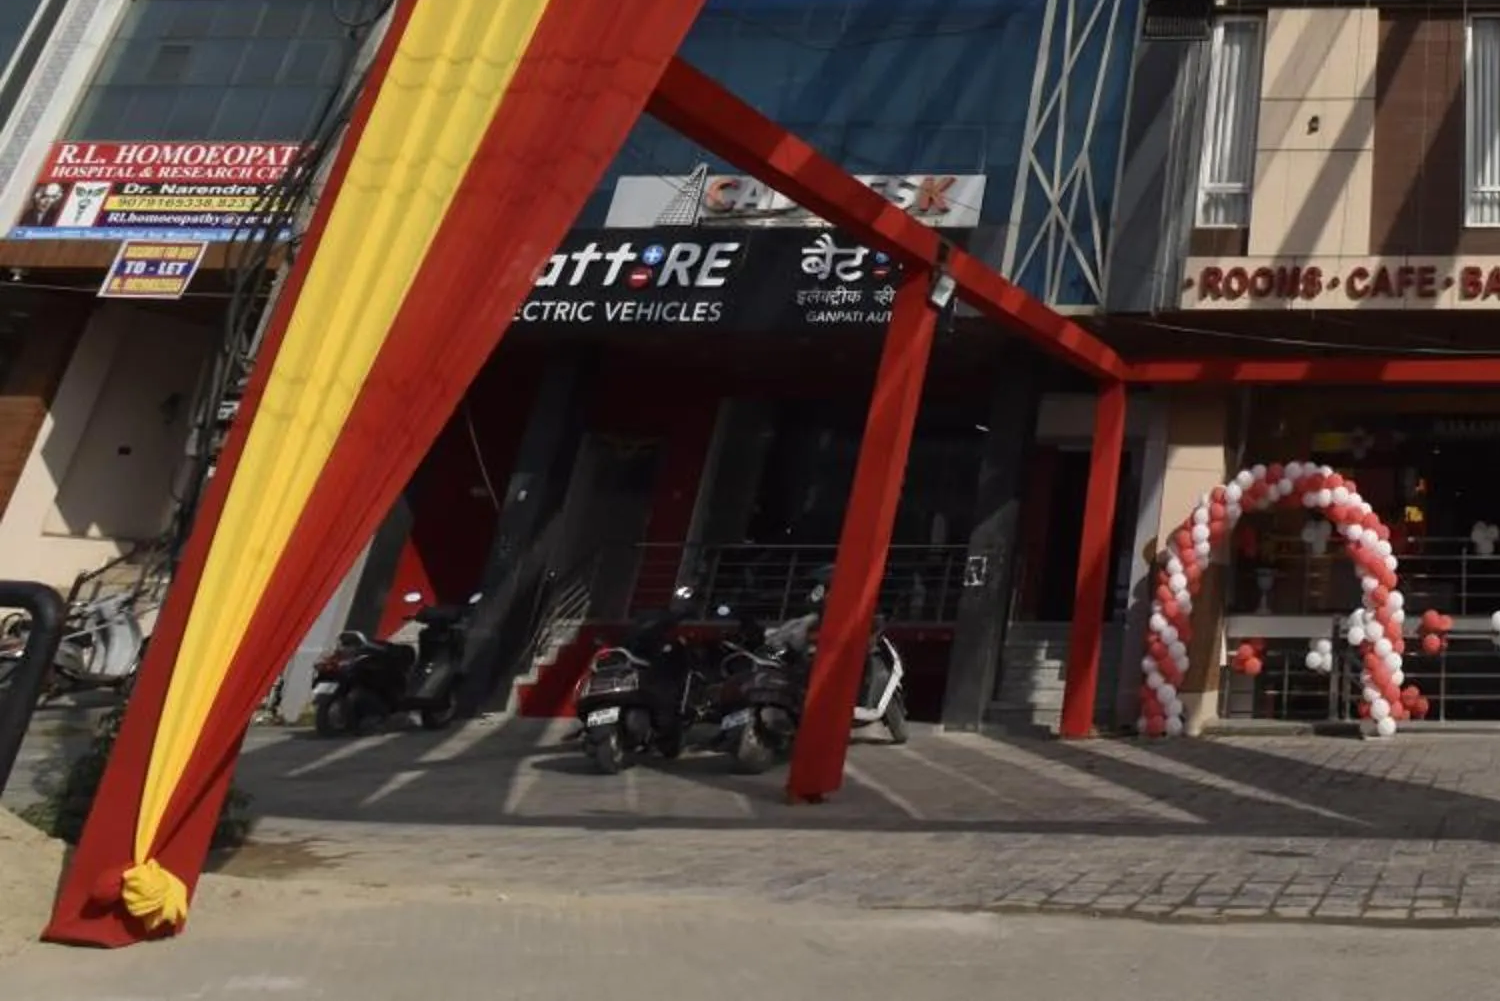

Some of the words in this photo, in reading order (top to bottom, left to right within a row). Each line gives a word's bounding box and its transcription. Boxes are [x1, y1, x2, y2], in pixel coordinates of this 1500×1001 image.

[57, 144, 107, 165] R.L.
[51, 166, 136, 178] HOSPITAL
[139, 167, 153, 178] &
[157, 166, 253, 179] RESEARCH
[123, 183, 152, 194] Dr.
[160, 184, 257, 195] Narendra
[124, 260, 147, 274] TO
[158, 260, 188, 275] LET
[1200, 266, 1322, 300] ROOMS
[1345, 266, 1438, 300] CAFE
[605, 302, 723, 322] VEHICLES
[806, 310, 863, 322] GANPATI
